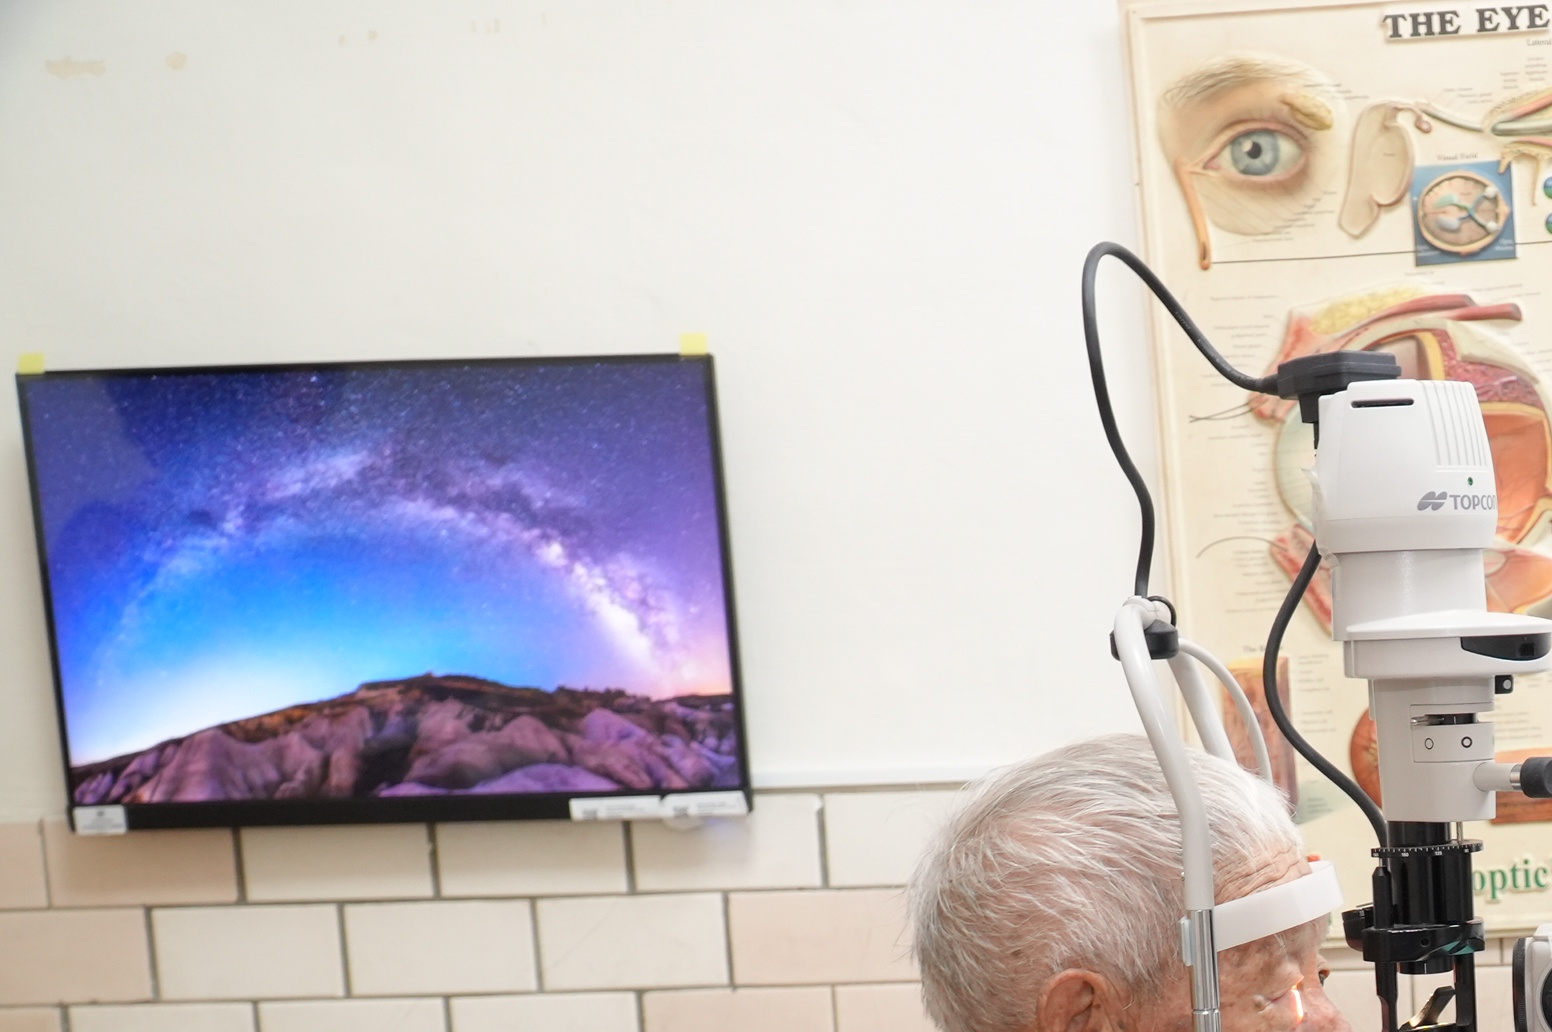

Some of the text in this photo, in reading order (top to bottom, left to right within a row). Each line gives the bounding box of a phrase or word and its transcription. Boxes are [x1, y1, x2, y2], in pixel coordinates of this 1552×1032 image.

[1382, 3, 1551, 39] THE EYE
[1448, 494, 1498, 510] TOPCON
[1473, 859, 1548, 902] optic
